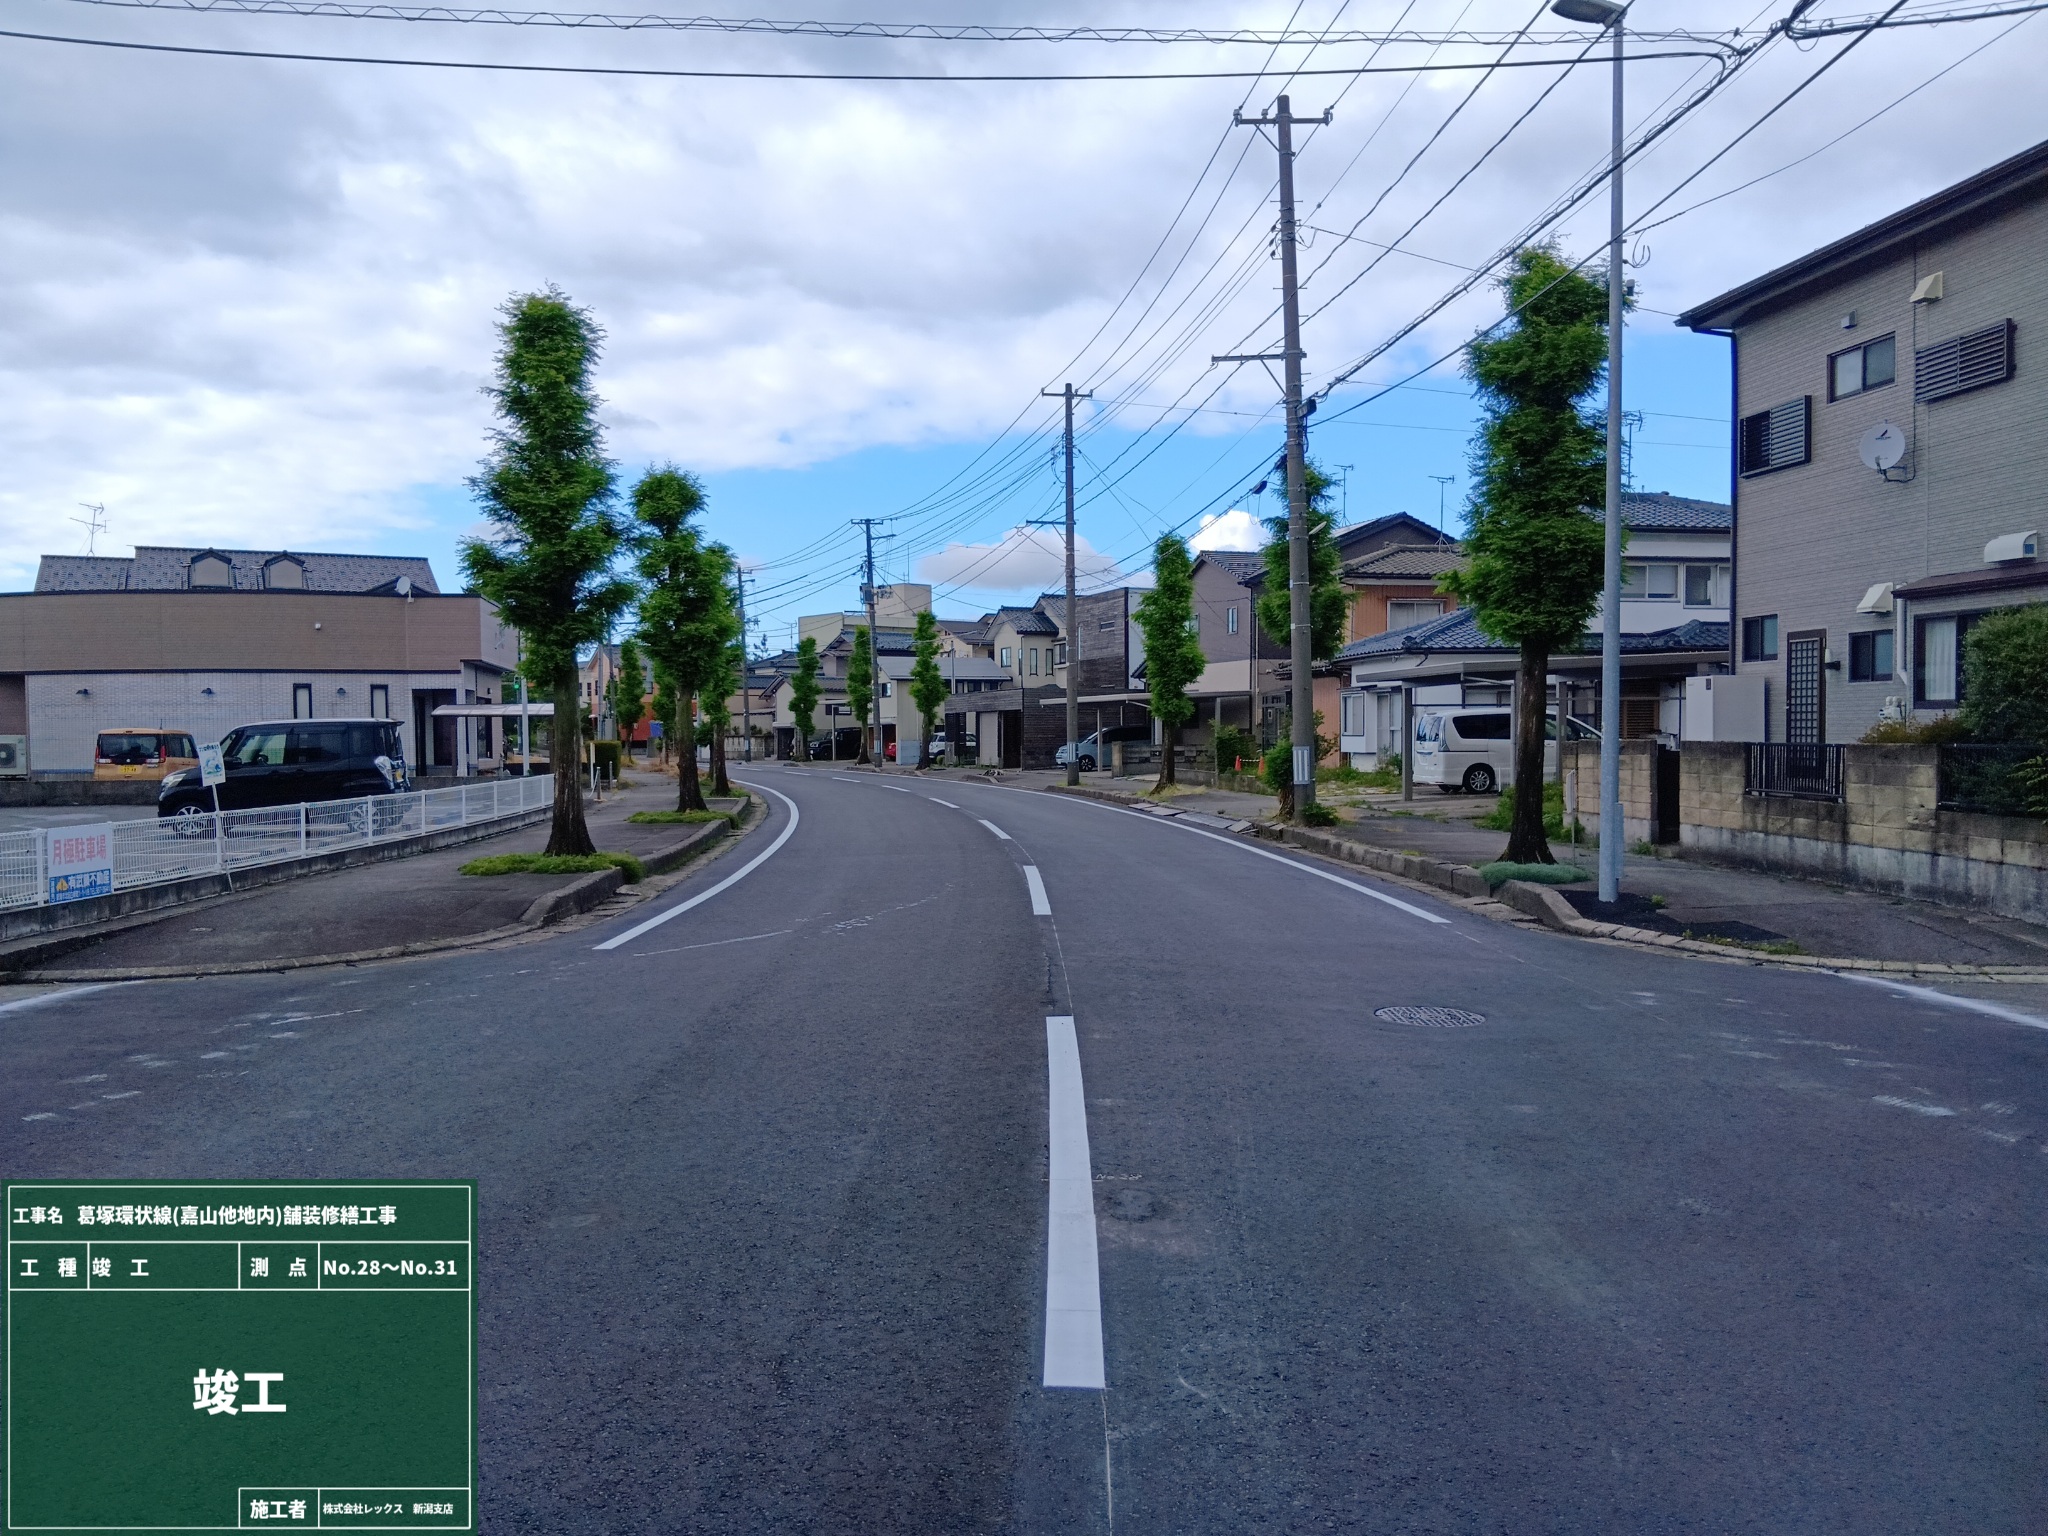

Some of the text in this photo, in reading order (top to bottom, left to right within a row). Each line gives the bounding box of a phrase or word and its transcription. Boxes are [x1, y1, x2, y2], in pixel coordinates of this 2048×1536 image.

[53, 834, 107, 866] 月極駐車場
